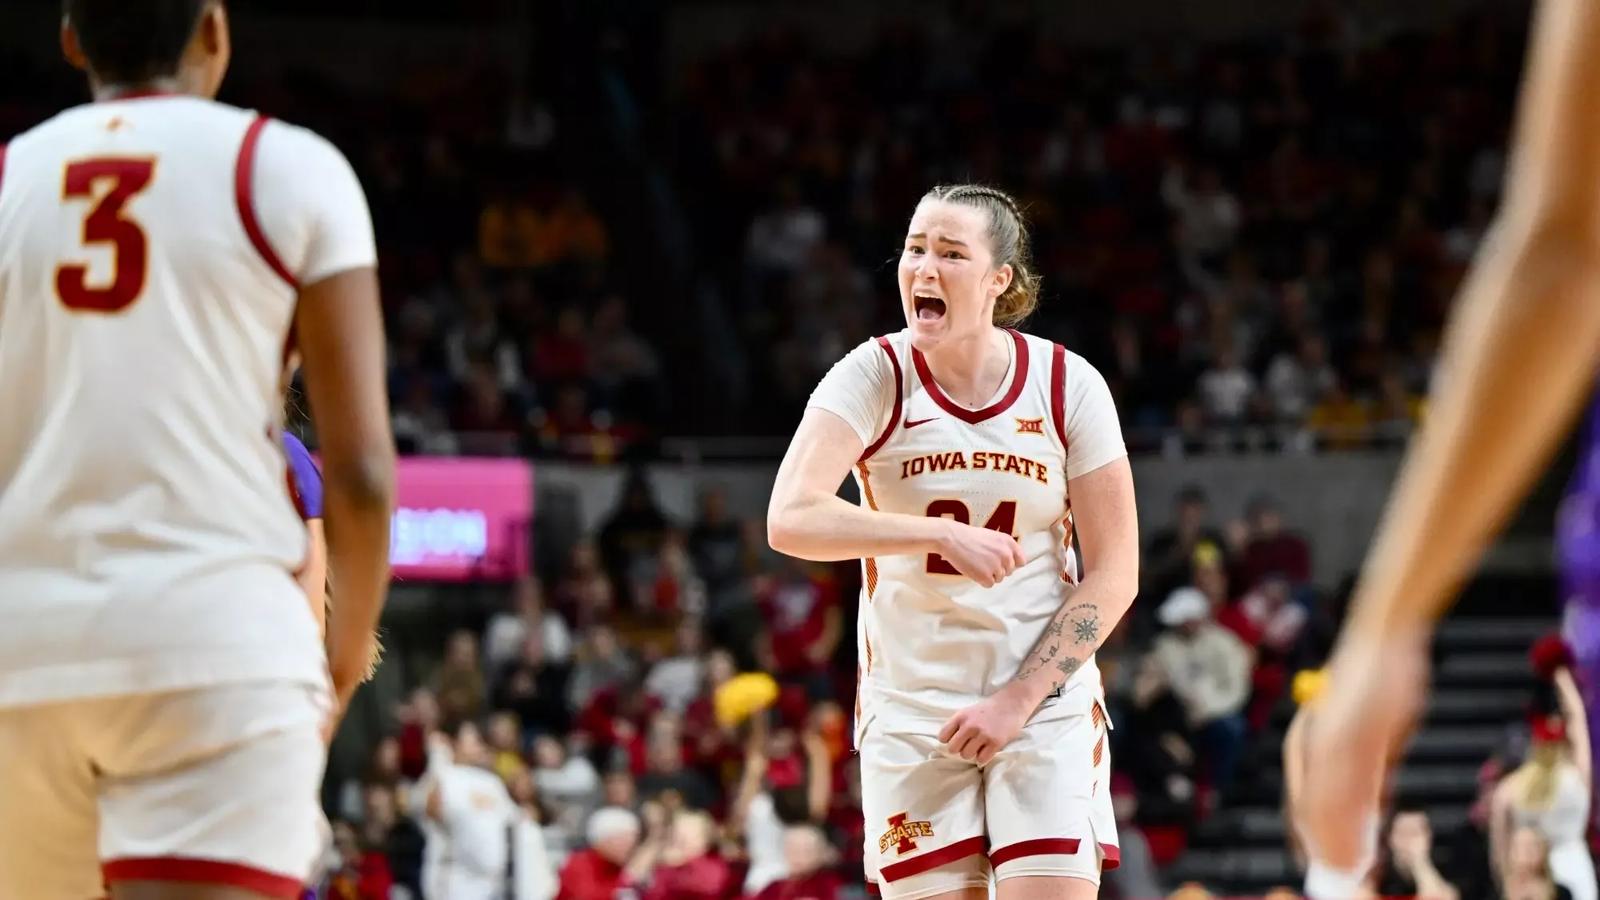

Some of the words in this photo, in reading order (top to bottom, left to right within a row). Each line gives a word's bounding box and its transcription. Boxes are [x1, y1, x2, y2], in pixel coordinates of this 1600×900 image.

[54, 155, 158, 314] 3
[1015, 417, 1044, 436] XII
[901, 452, 966, 480] IOWA
[972, 452, 1049, 484] STATE
[878, 821, 934, 854] STATE
